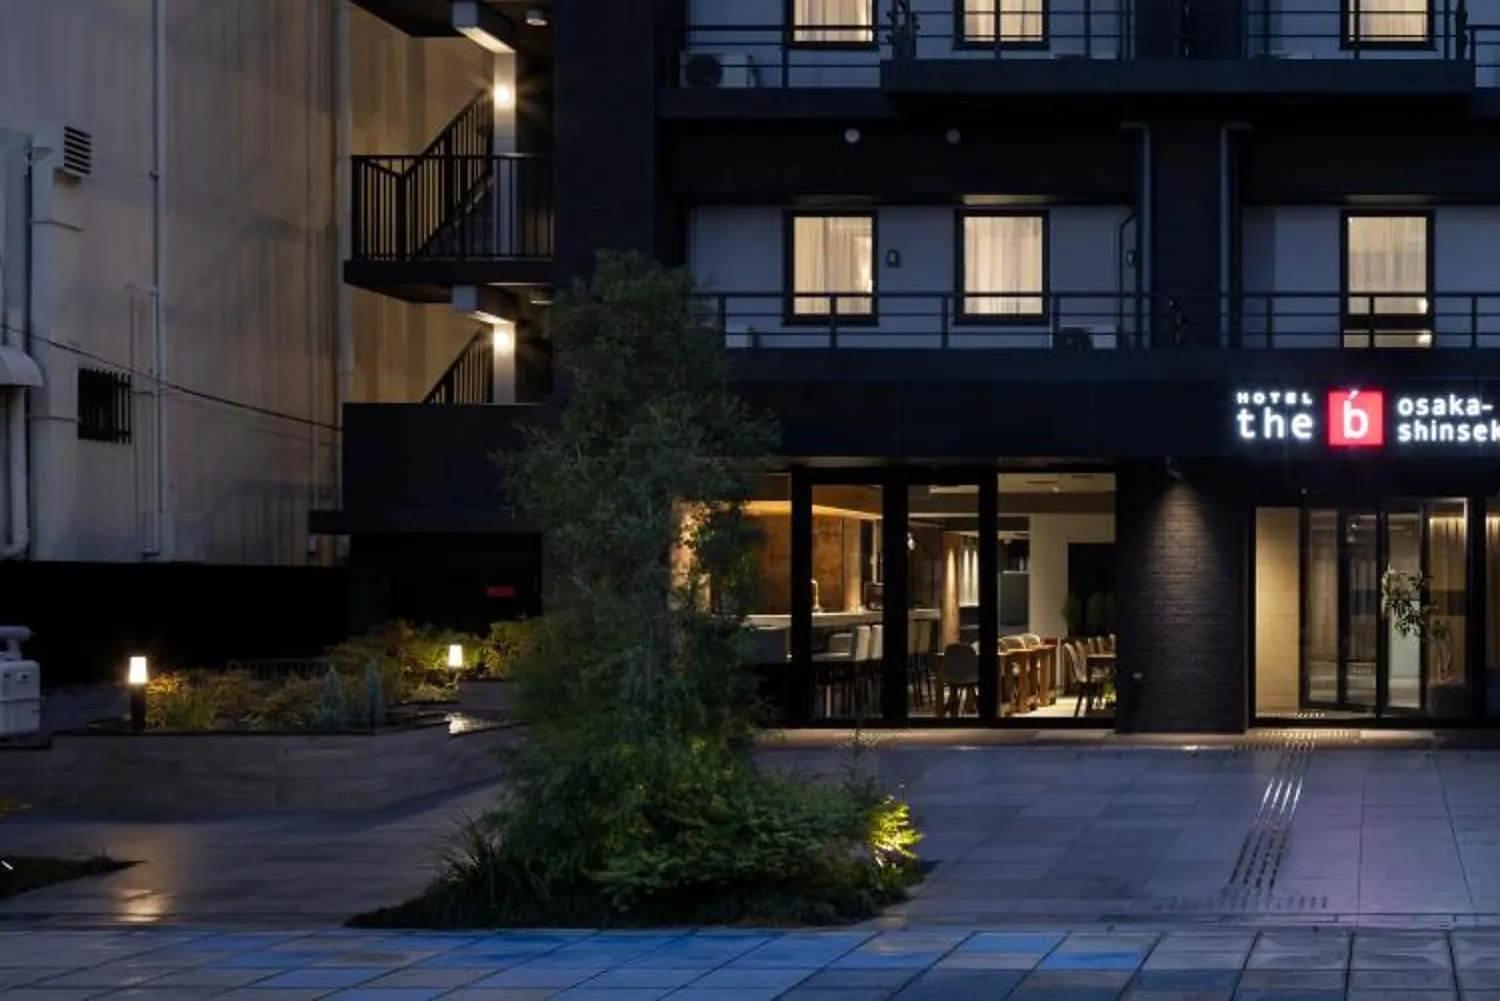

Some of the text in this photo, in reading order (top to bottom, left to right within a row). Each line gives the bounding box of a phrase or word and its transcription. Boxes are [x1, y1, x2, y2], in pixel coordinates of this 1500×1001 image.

[1236, 392, 1313, 405] HOTEL
[1397, 394, 1493, 416] osaka-
[1236, 406, 1314, 440] the
